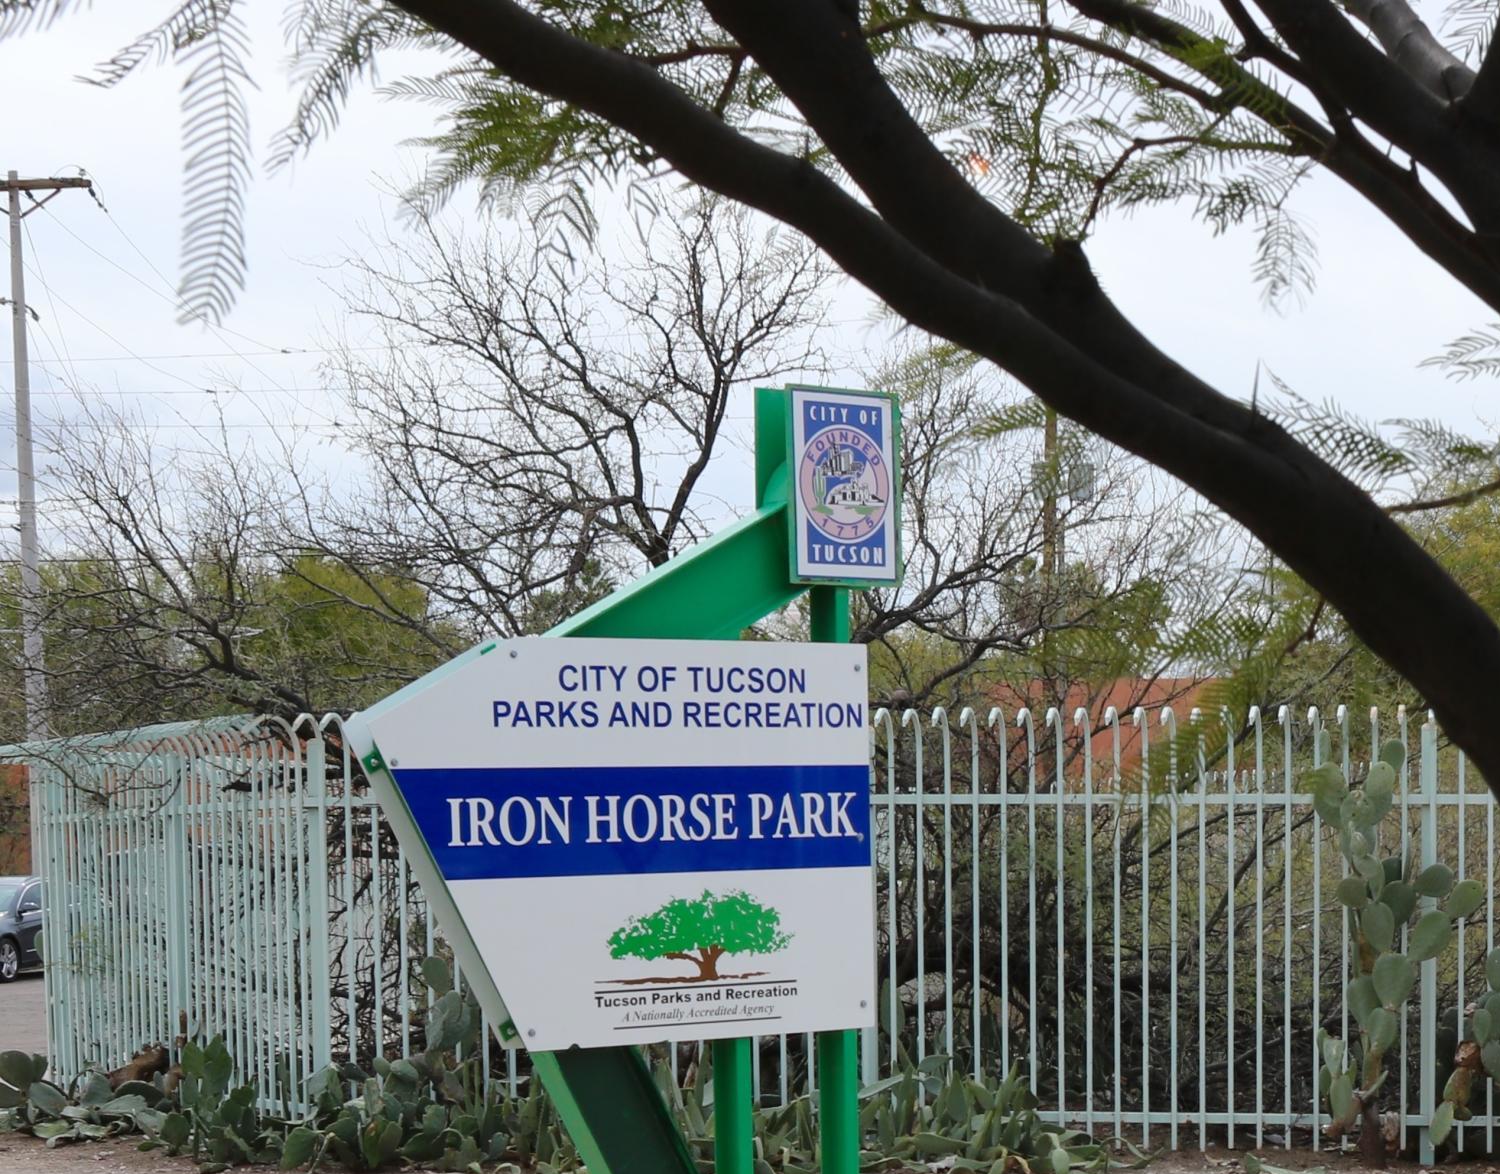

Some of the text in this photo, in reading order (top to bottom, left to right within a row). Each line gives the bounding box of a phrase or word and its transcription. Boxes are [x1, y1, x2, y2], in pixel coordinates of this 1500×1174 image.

[809, 405, 878, 426] CITY OF
[806, 431, 881, 467] FOUNDED
[821, 518, 875, 536] 1775
[812, 543, 883, 565] TUCSON
[558, 665, 806, 693] CITY OF TUCSON
[492, 700, 863, 728] PARKS AND RECREATION
[446, 791, 858, 847] IRON HORSE PARK
[595, 985, 798, 1008] Tucson Parks and Recreation
[622, 1003, 775, 1023] A Nationally Accredited Agency
